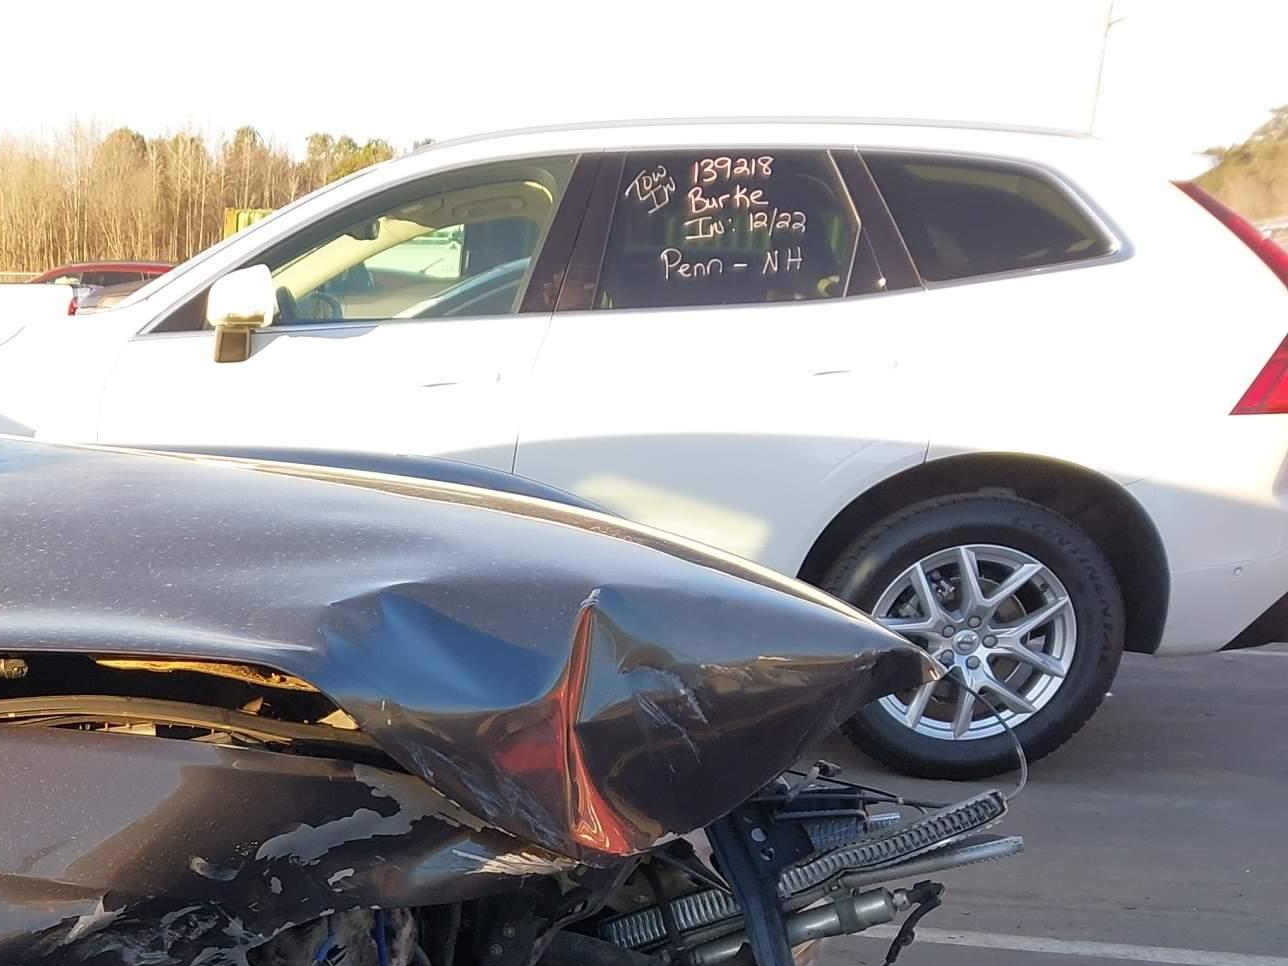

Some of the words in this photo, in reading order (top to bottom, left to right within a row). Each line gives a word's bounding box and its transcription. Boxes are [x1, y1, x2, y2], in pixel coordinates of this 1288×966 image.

[693, 156, 774, 184] 139218
[749, 208, 807, 237] 12/22
[661, 248, 724, 281] Penn
